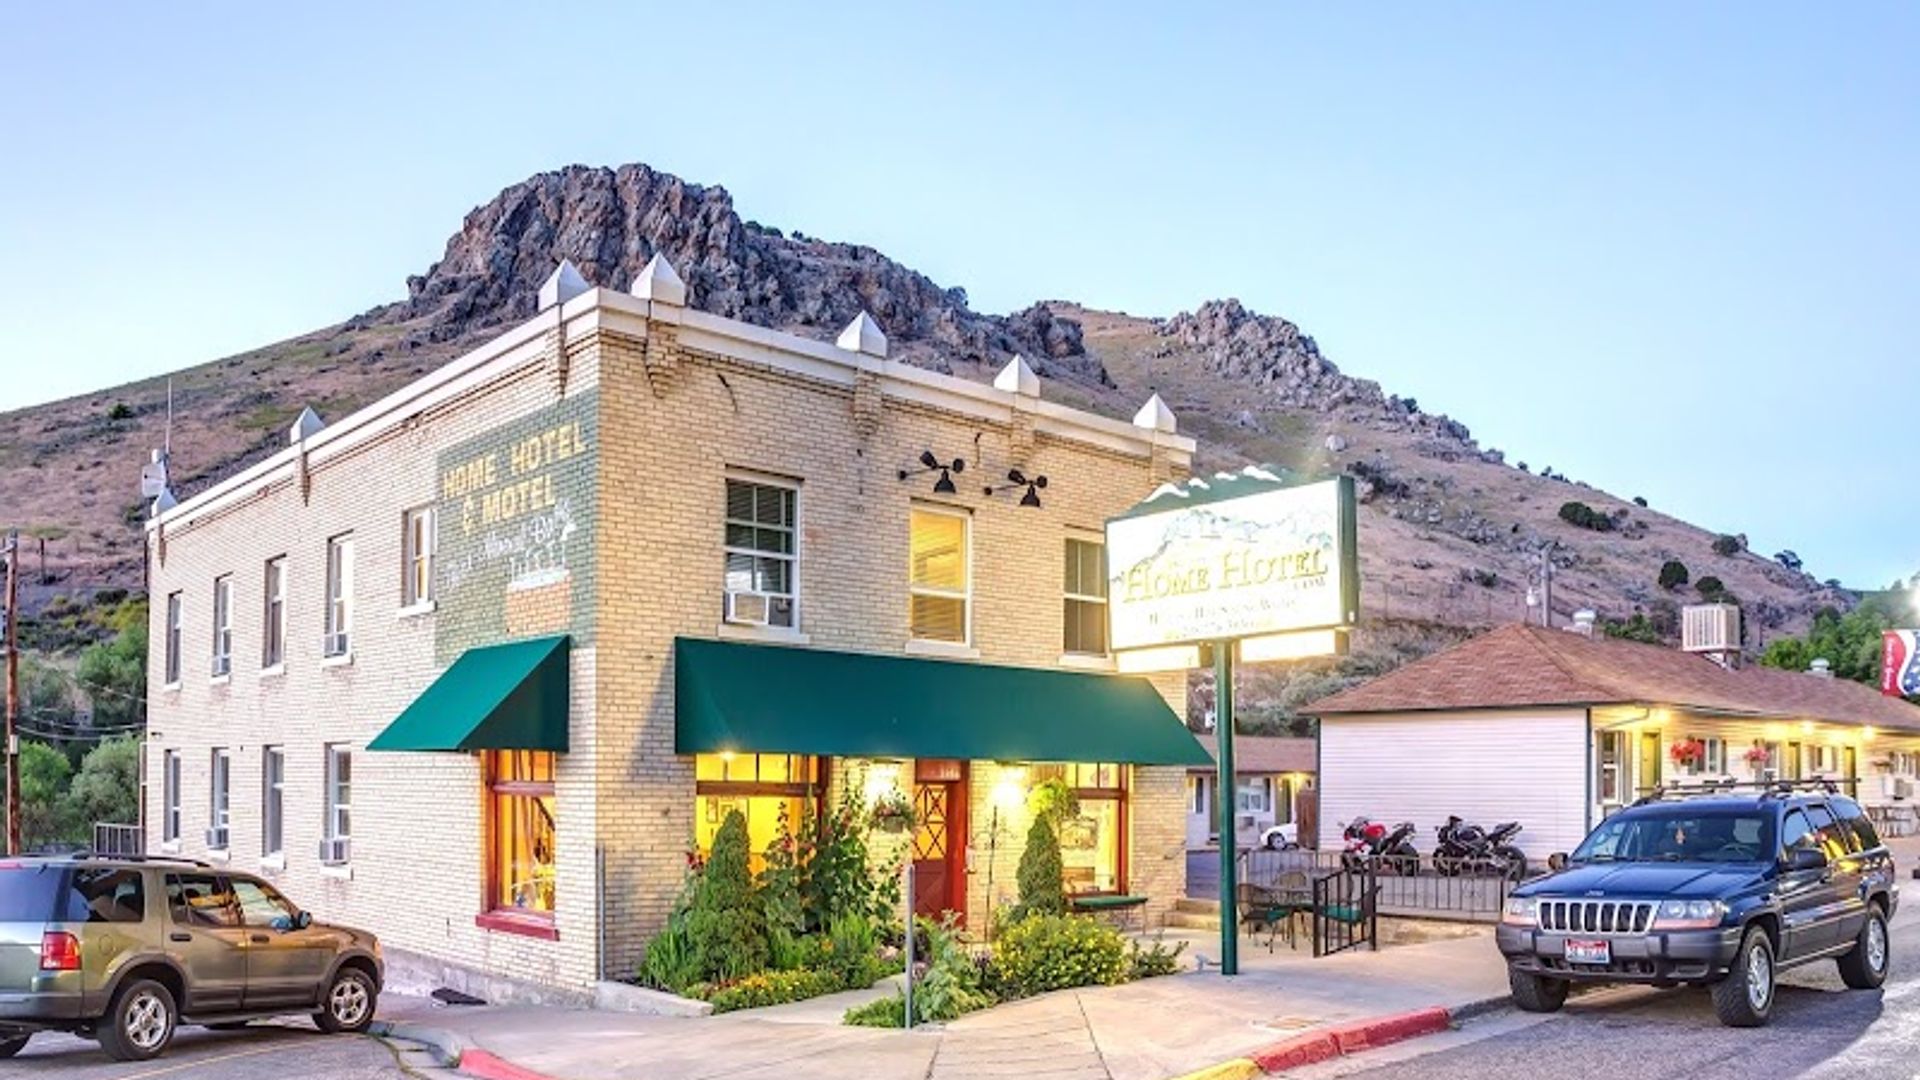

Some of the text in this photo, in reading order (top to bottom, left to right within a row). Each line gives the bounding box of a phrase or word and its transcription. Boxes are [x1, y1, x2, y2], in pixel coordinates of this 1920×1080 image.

[443, 421, 587, 499] HOME HOTEL
[481, 473, 557, 524] MOTEL
